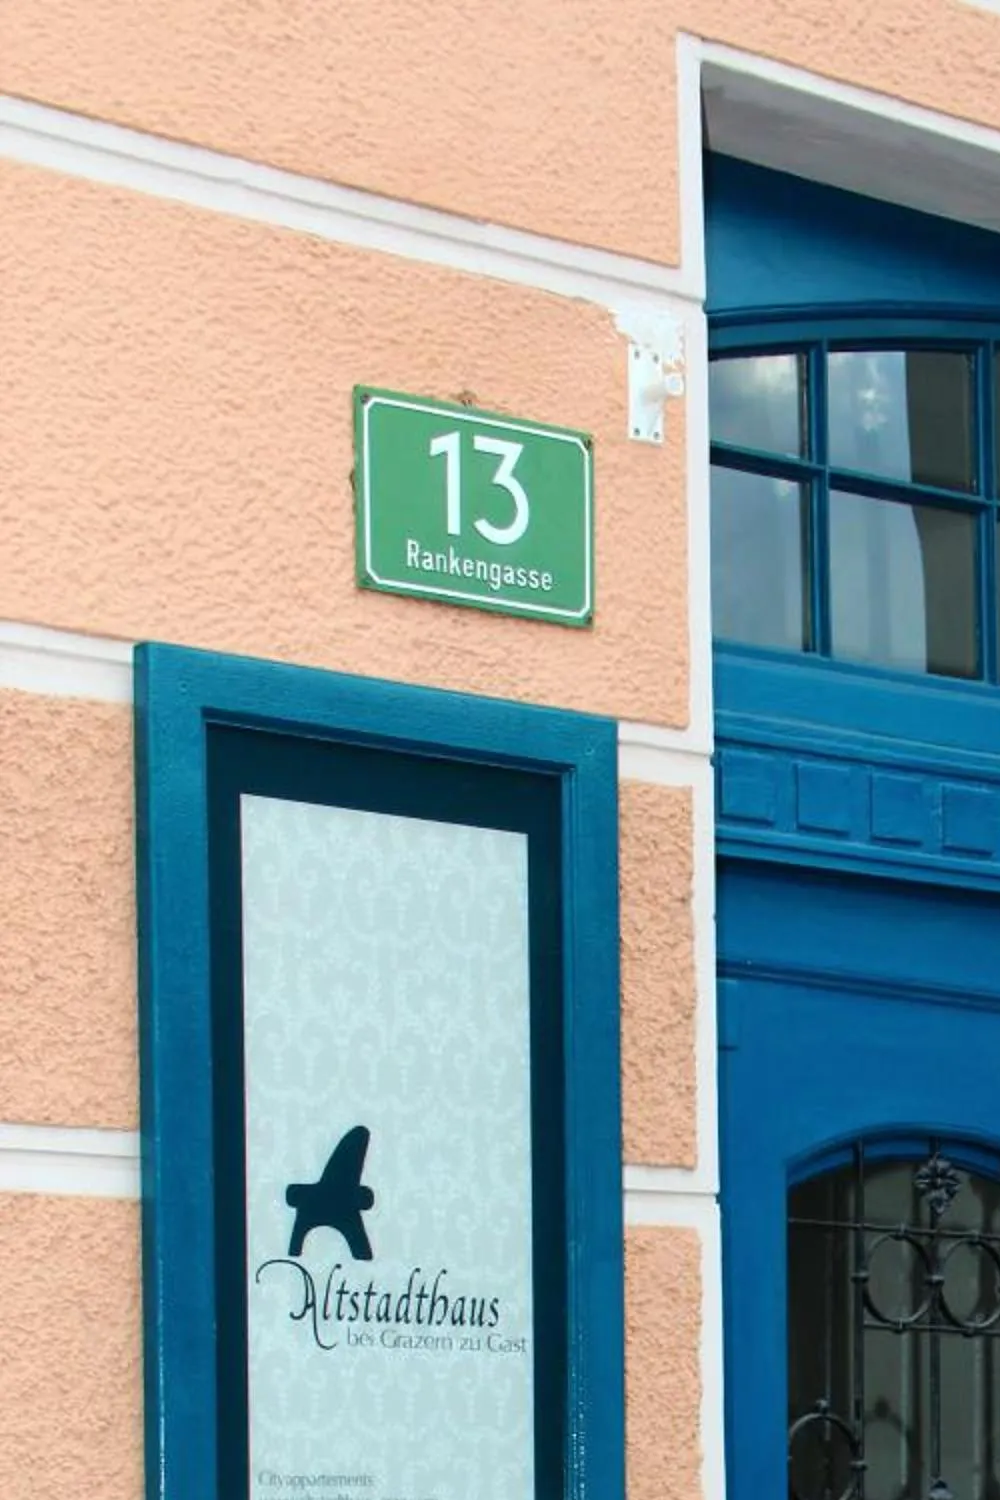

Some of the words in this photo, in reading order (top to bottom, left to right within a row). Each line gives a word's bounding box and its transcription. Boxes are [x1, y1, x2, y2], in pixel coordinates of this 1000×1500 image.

[429, 431, 530, 545] 13
[405, 538, 553, 591] Rankengasse
[256, 1259, 500, 1350] Altstadthaus
[346, 1326, 375, 1348] bei
[379, 1328, 453, 1351] Grazern
[459, 1334, 481, 1352] zu
[486, 1333, 528, 1354] Gast
